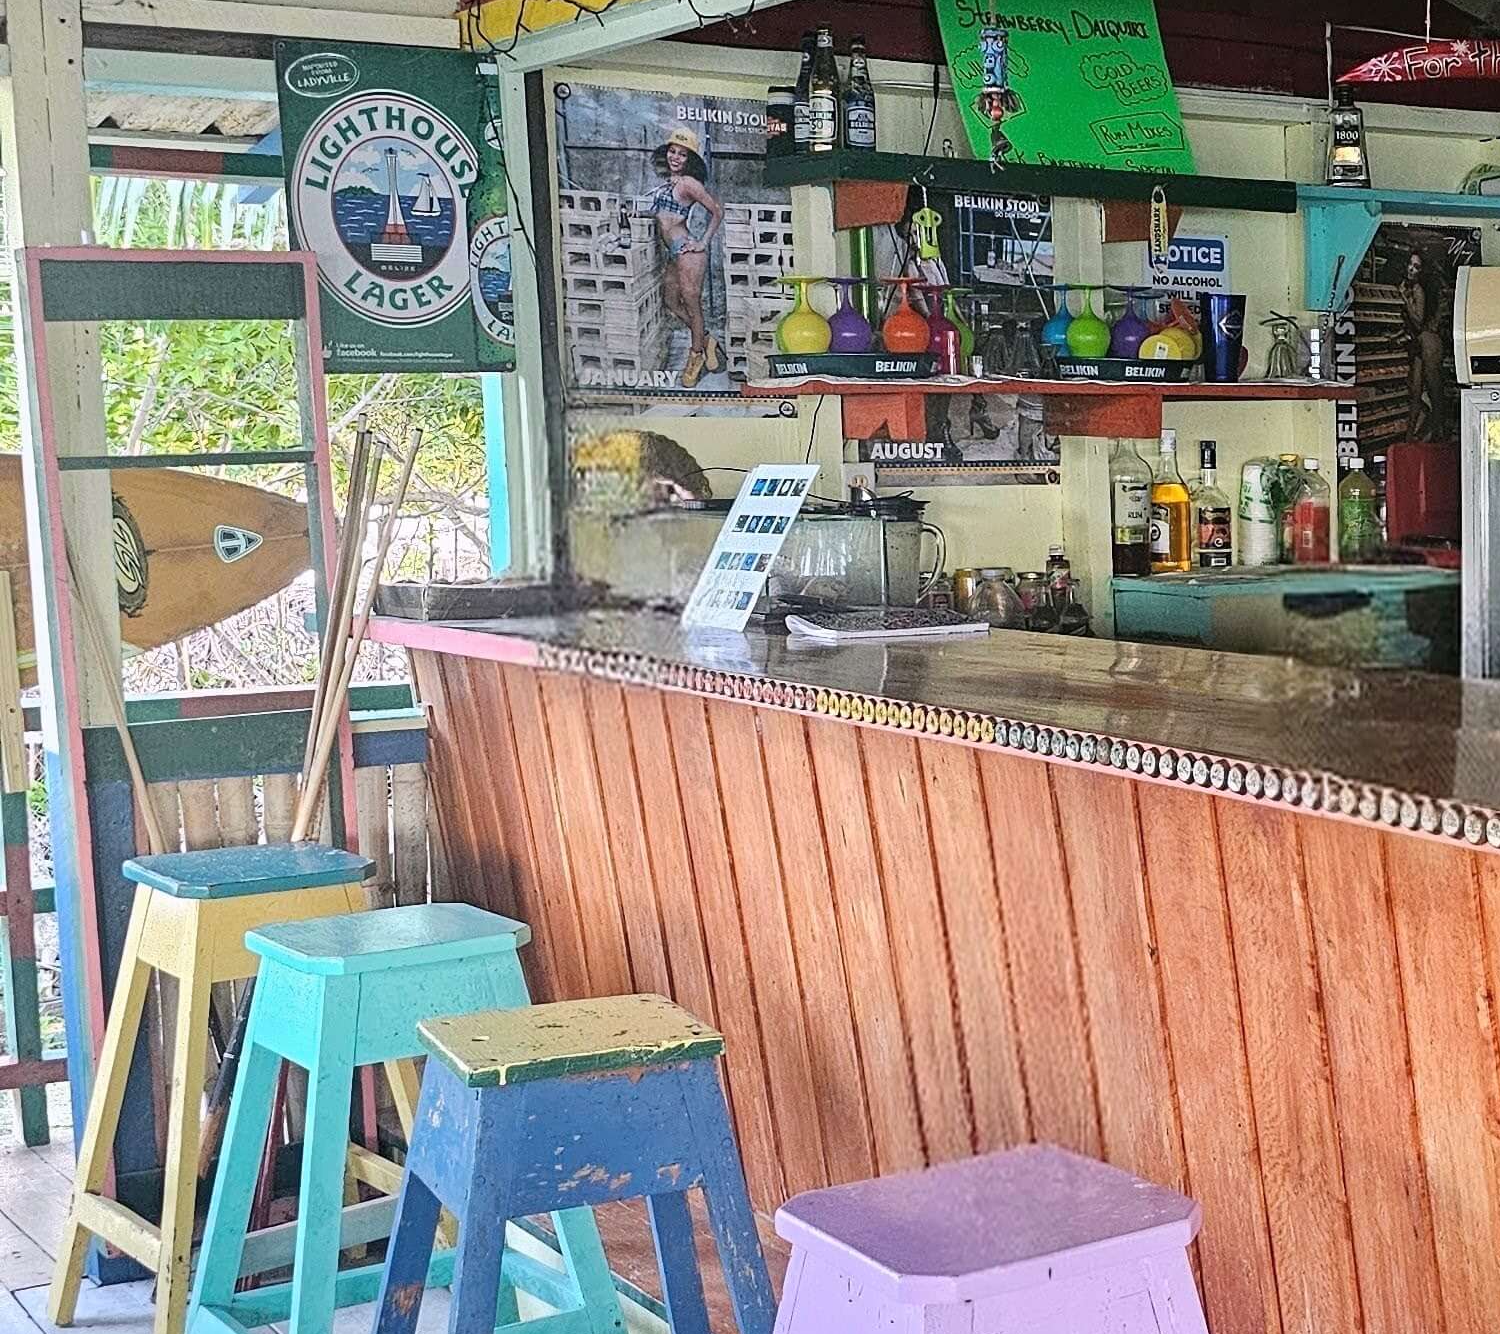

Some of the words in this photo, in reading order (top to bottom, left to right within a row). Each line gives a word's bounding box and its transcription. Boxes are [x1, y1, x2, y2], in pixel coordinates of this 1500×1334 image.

[1093, 63, 1134, 82] COLD
[1402, 46, 1463, 81] For
[297, 72, 352, 89] LADYVILLE
[1117, 75, 1162, 100] BEERS
[676, 104, 737, 125] BELIKIN
[737, 111, 768, 128] STOU
[1335, 129, 1359, 140] 1800
[954, 194, 1004, 211] BELIKIN
[1006, 198, 1040, 213] STOUT
[1166, 244, 1223, 265] OTICE
[1152, 274, 1170, 286] NO
[1171, 275, 1223, 288] ALCOHOL
[343, 271, 454, 312] LAGER
[1167, 290, 1193, 301] WILL
[336, 348, 377, 357] facebook
[775, 362, 809, 376] BELIKIN
[874, 359, 918, 373] BELIKIN
[1059, 364, 1099, 377] BELIKIN
[1124, 366, 1166, 379] BELIKIN
[578, 368, 681, 388] JANUARY
[869, 442, 946, 461] AUGUST
